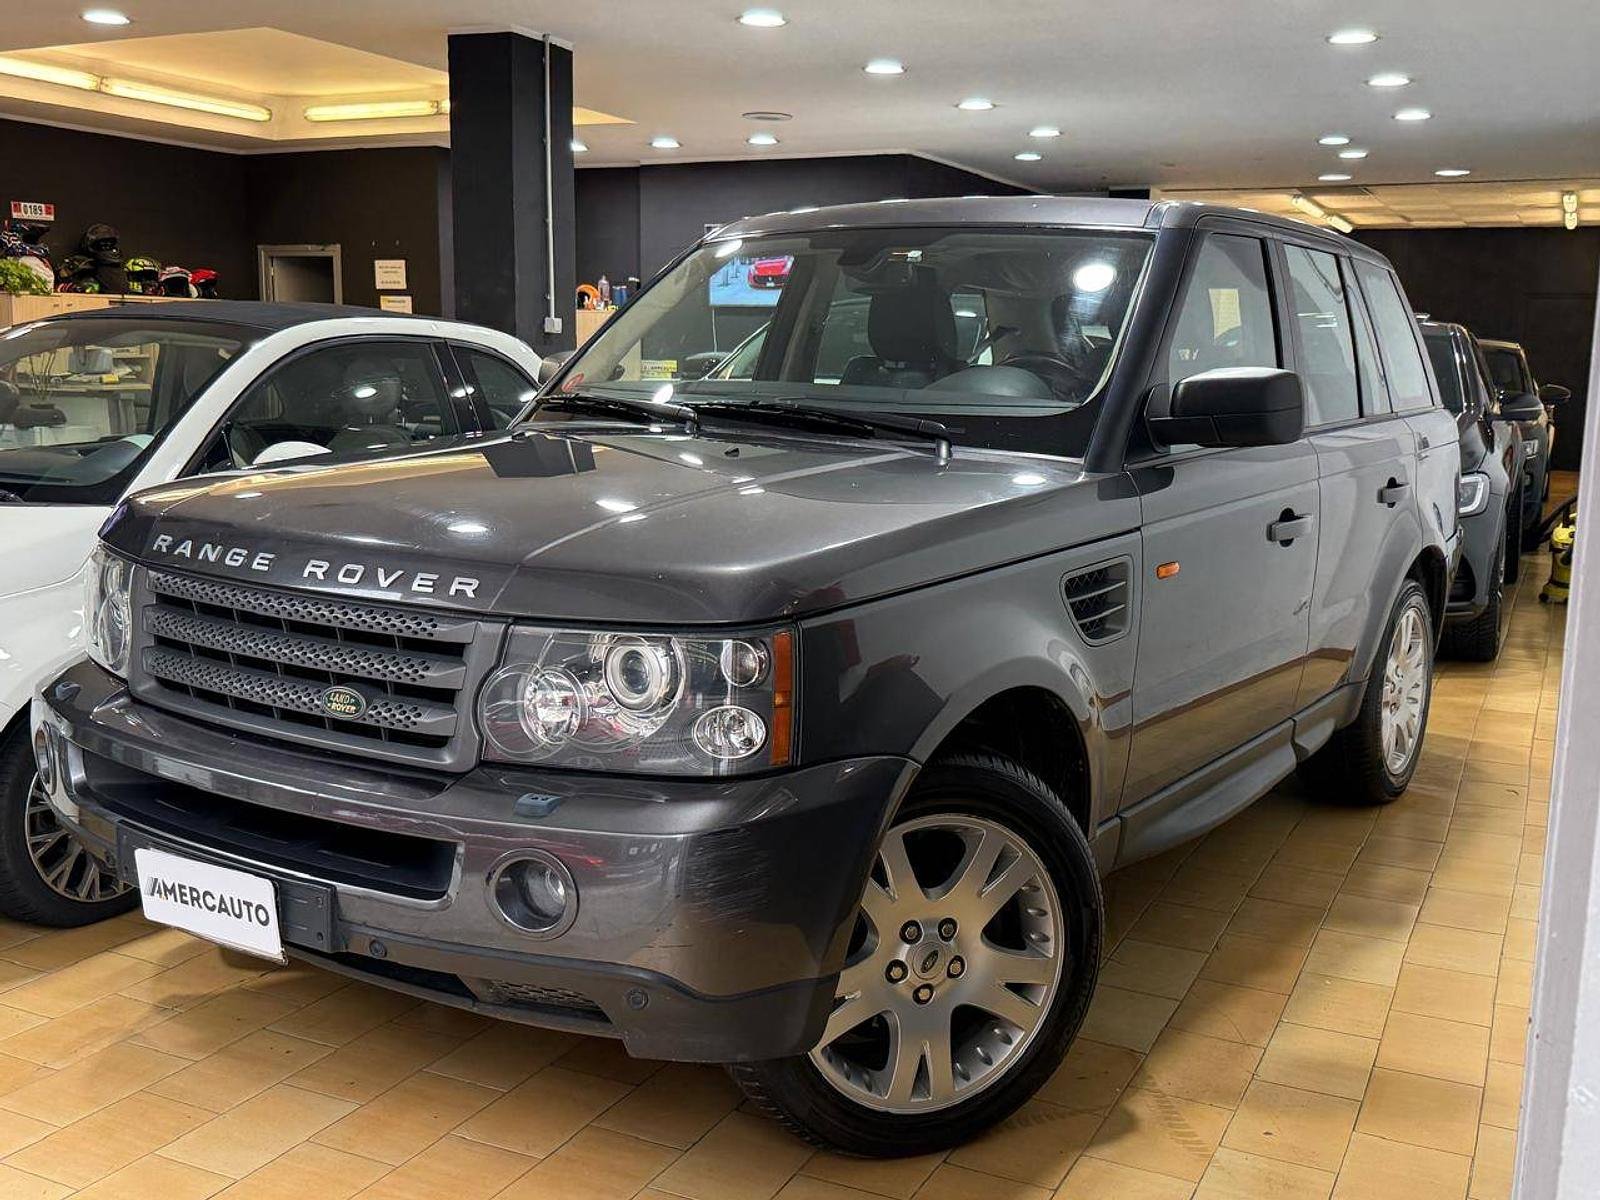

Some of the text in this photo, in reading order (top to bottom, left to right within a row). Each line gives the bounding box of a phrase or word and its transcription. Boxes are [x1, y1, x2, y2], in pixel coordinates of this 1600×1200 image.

[152, 534, 480, 599] RANGE ROVER
[330, 692, 350, 704] LAND
[331, 702, 356, 714] ROVER
[147, 876, 270, 927] AMERCAUTO
